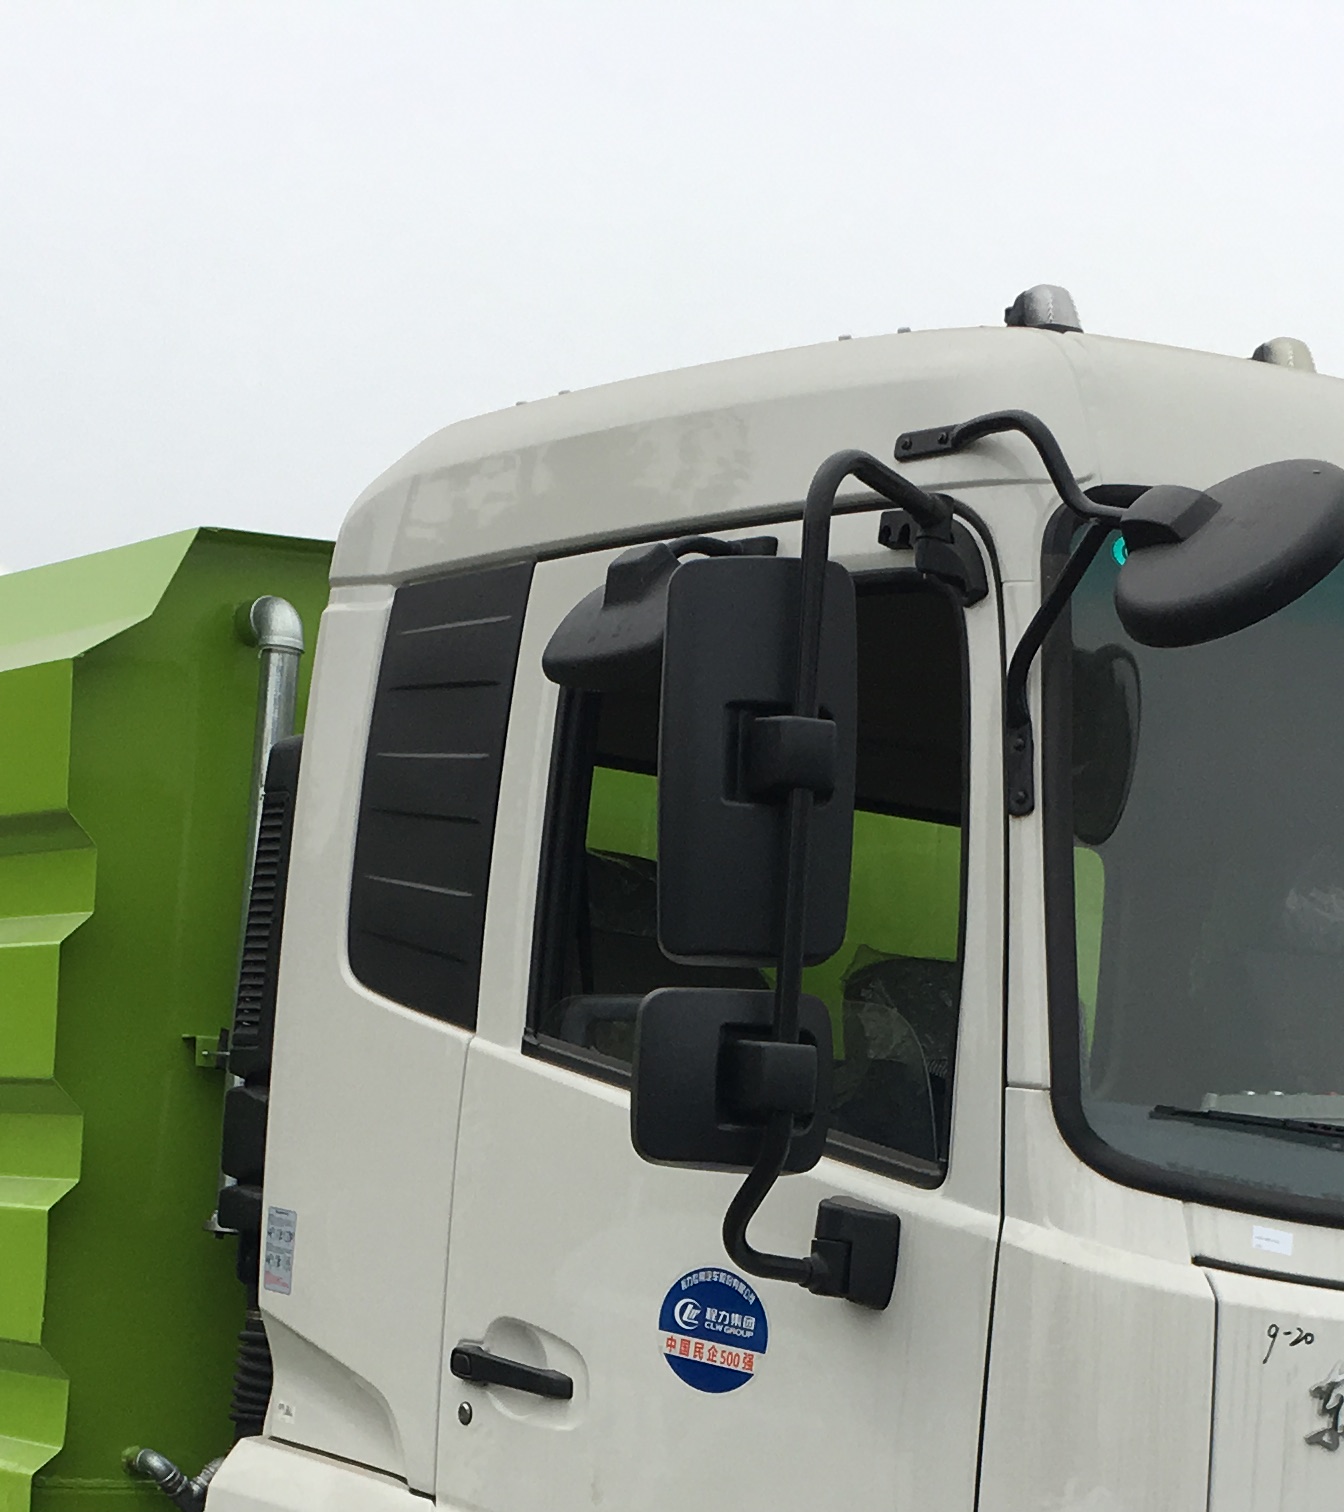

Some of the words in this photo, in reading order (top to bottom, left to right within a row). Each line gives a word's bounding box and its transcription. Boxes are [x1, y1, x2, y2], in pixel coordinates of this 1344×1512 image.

[704, 1321, 724, 1332] CLW
[723, 1326, 754, 1338] GROUP
[705, 1307, 756, 1330] 程力集团
[666, 1335, 754, 1372] 中国民企500强
